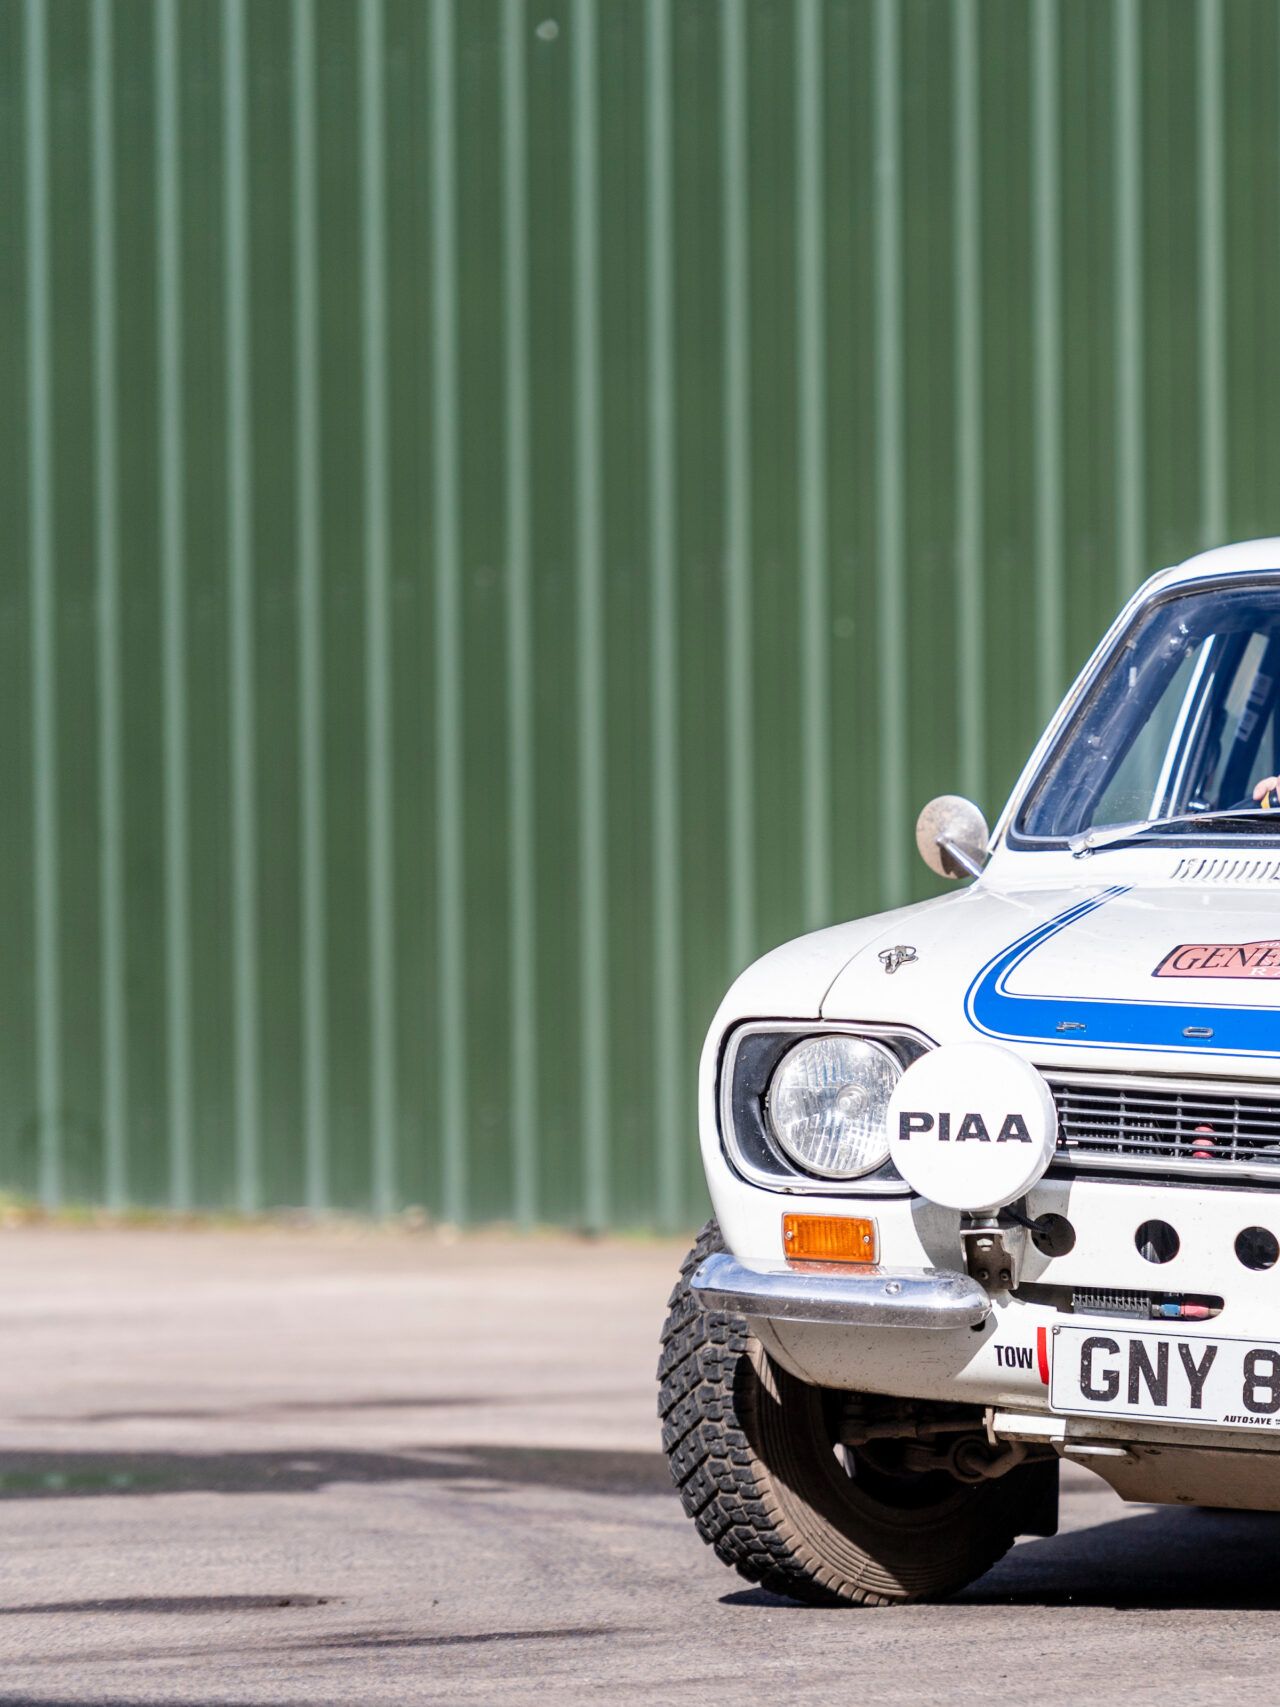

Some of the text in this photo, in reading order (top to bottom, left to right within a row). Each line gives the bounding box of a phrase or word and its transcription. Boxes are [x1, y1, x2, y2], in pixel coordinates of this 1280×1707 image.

[899, 1111, 1033, 1143] PIAA
[994, 1345, 1033, 1370] TOW
[1080, 1335, 1218, 1410] GNY
[1223, 1415, 1272, 1426] AUTOSAVE
